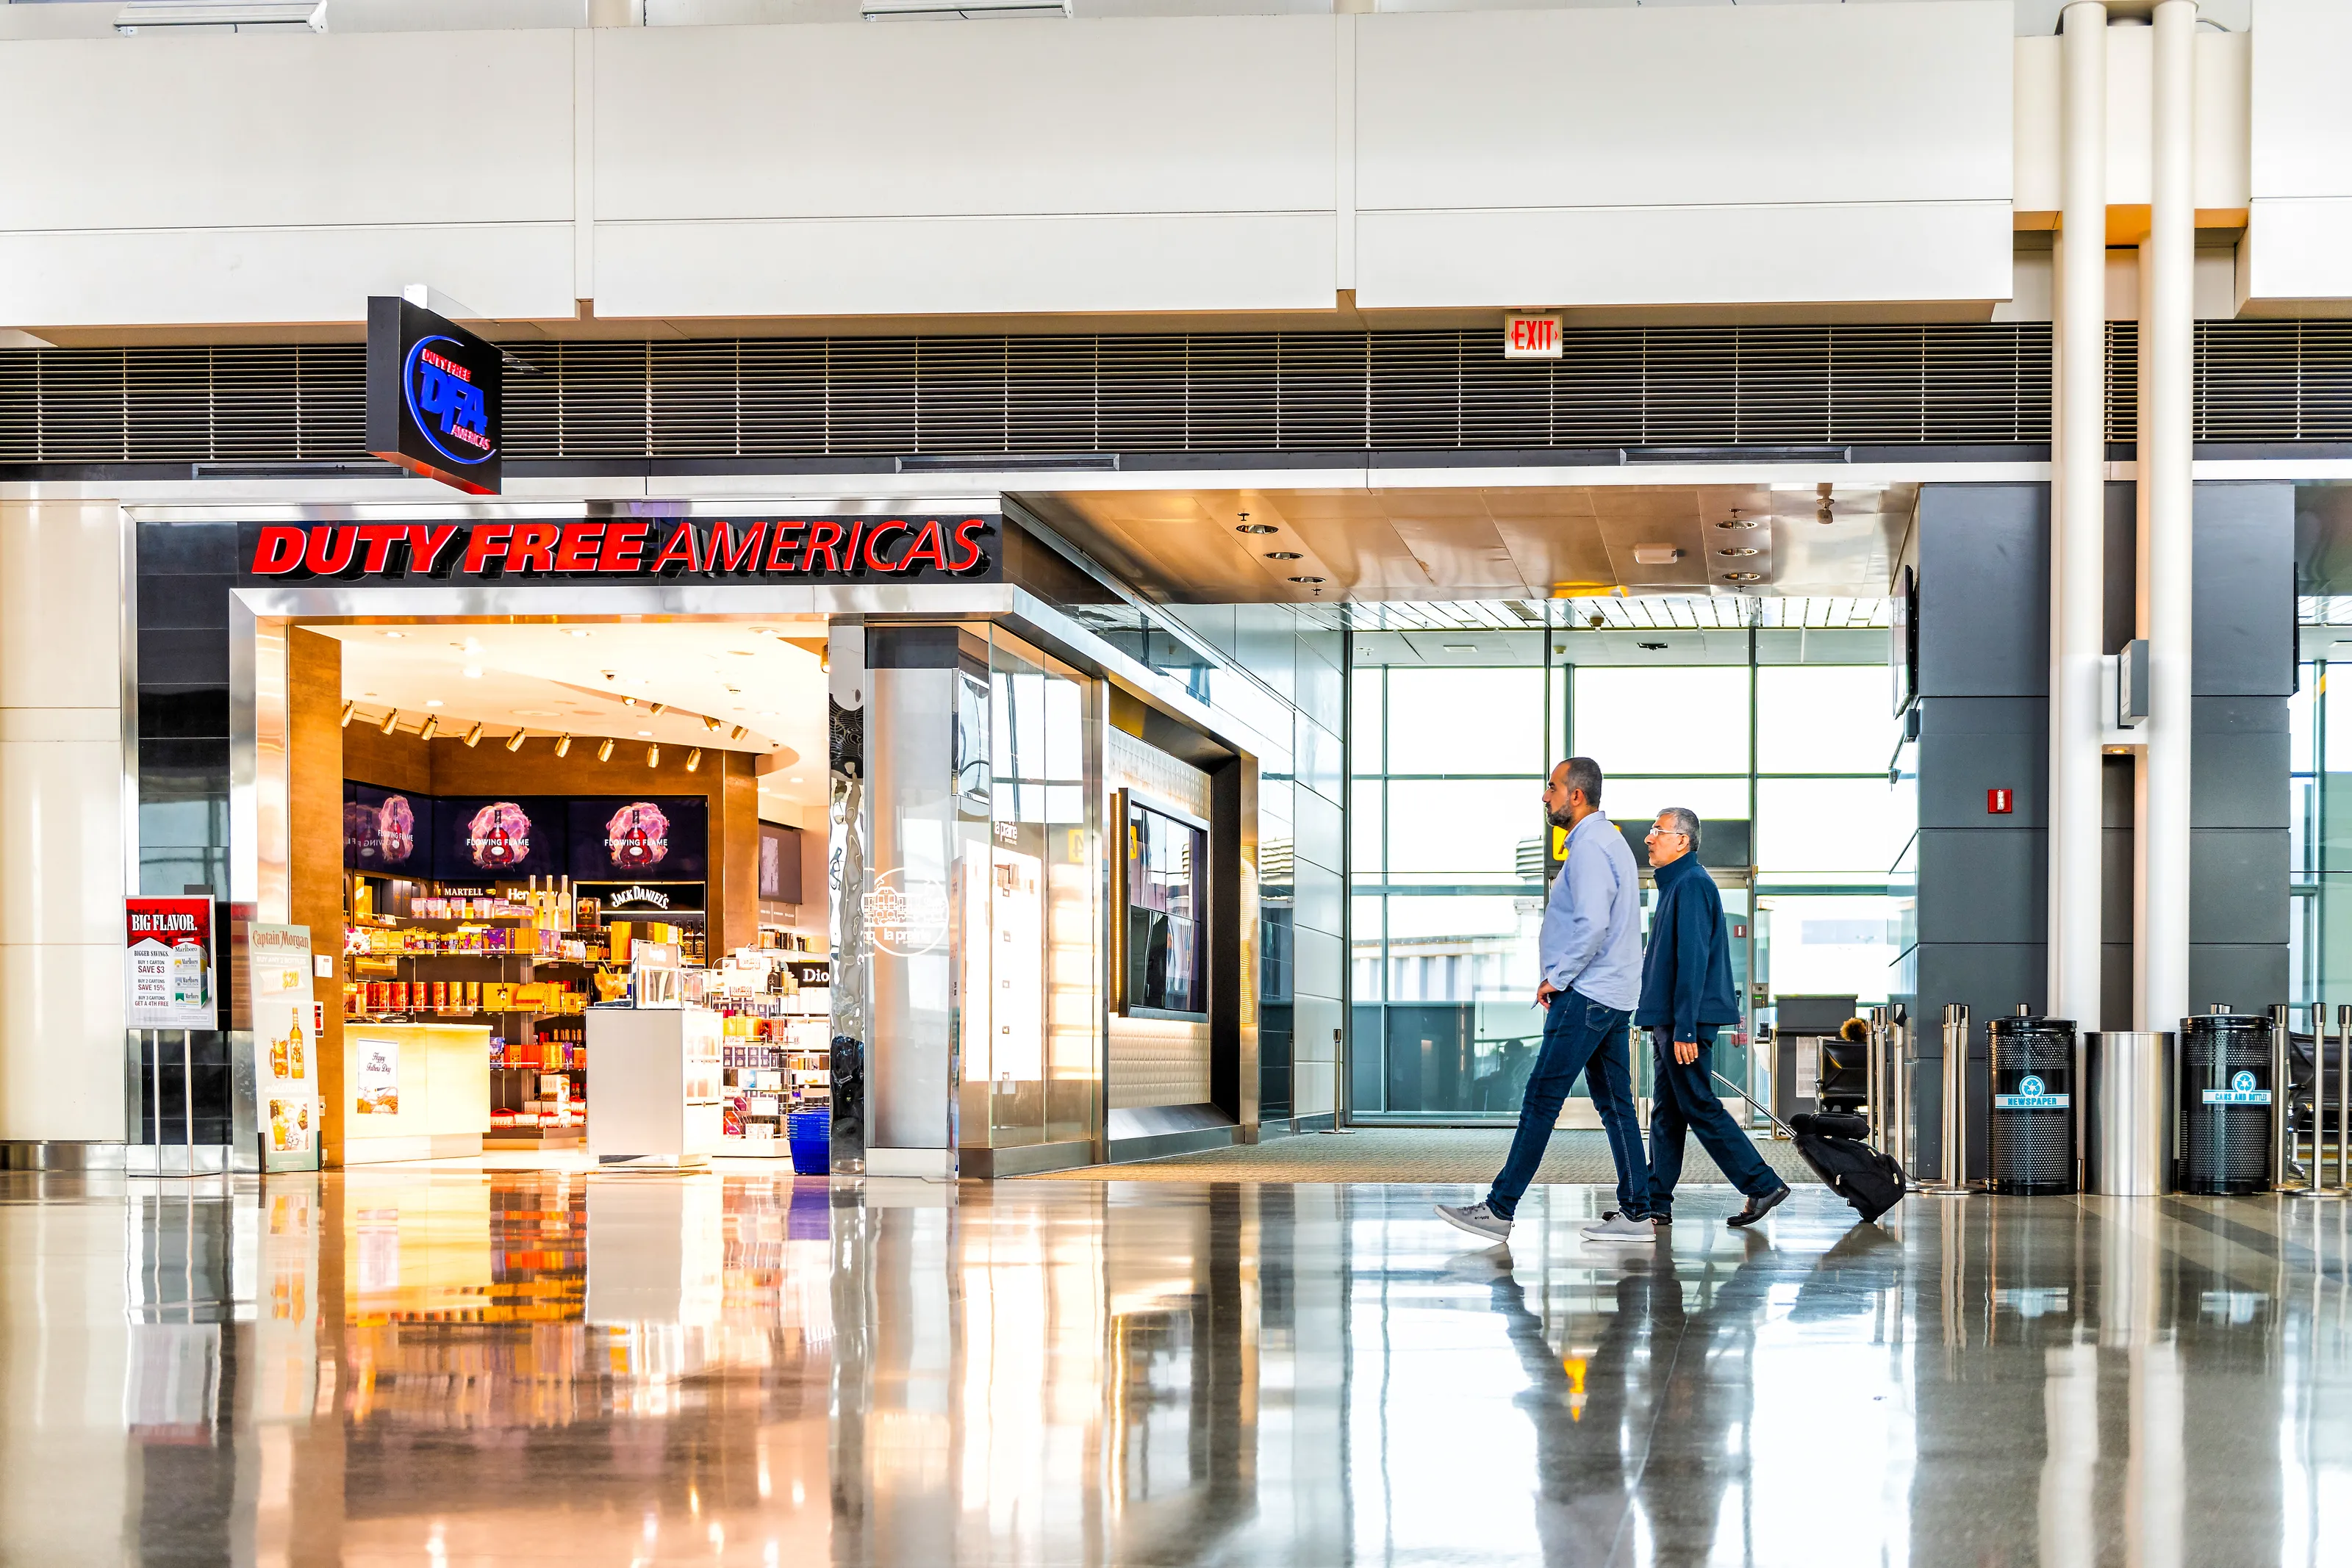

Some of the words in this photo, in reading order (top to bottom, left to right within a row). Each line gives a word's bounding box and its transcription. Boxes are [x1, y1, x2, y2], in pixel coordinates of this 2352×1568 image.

[1514, 320, 1554, 350] EXIT
[421, 348, 448, 371] DUTY
[447, 360, 471, 382] FREE
[419, 362, 488, 436] DFA
[451, 424, 490, 450] AMERICAS
[251, 525, 458, 575] DUTY
[463, 522, 650, 573] FREE
[650, 519, 984, 572] AMERICAS
[378, 829, 398, 839] FLOWING
[399, 832, 413, 842] FLAME
[604, 838, 640, 846] FLOWING
[642, 838, 668, 846] FLAME
[444, 888, 484, 896] MARTELL
[610, 888, 633, 908] JACK
[132, 914, 151, 931] BIG
[152, 914, 198, 931] FLAVOR.
[253, 929, 279, 949] Captain
[279, 930, 309, 949] Morgan
[883, 928, 894, 941] la
[175, 944, 198, 953] Marlboro
[182, 957, 198, 965] Marlboro
[138, 965, 155, 974] SAVE
[157, 965, 165, 974] $3
[282, 970, 299, 990] $29
[768, 977, 775, 985] ck
[372, 1052, 386, 1064] Happy
[381, 1063, 391, 1074] Day
[2007, 1097, 2057, 1105] NEWSPAPER
[2215, 1093, 2232, 1101] CANS
[2234, 1093, 2247, 1101] AND
[2248, 1093, 2267, 1101] BOTTLES
